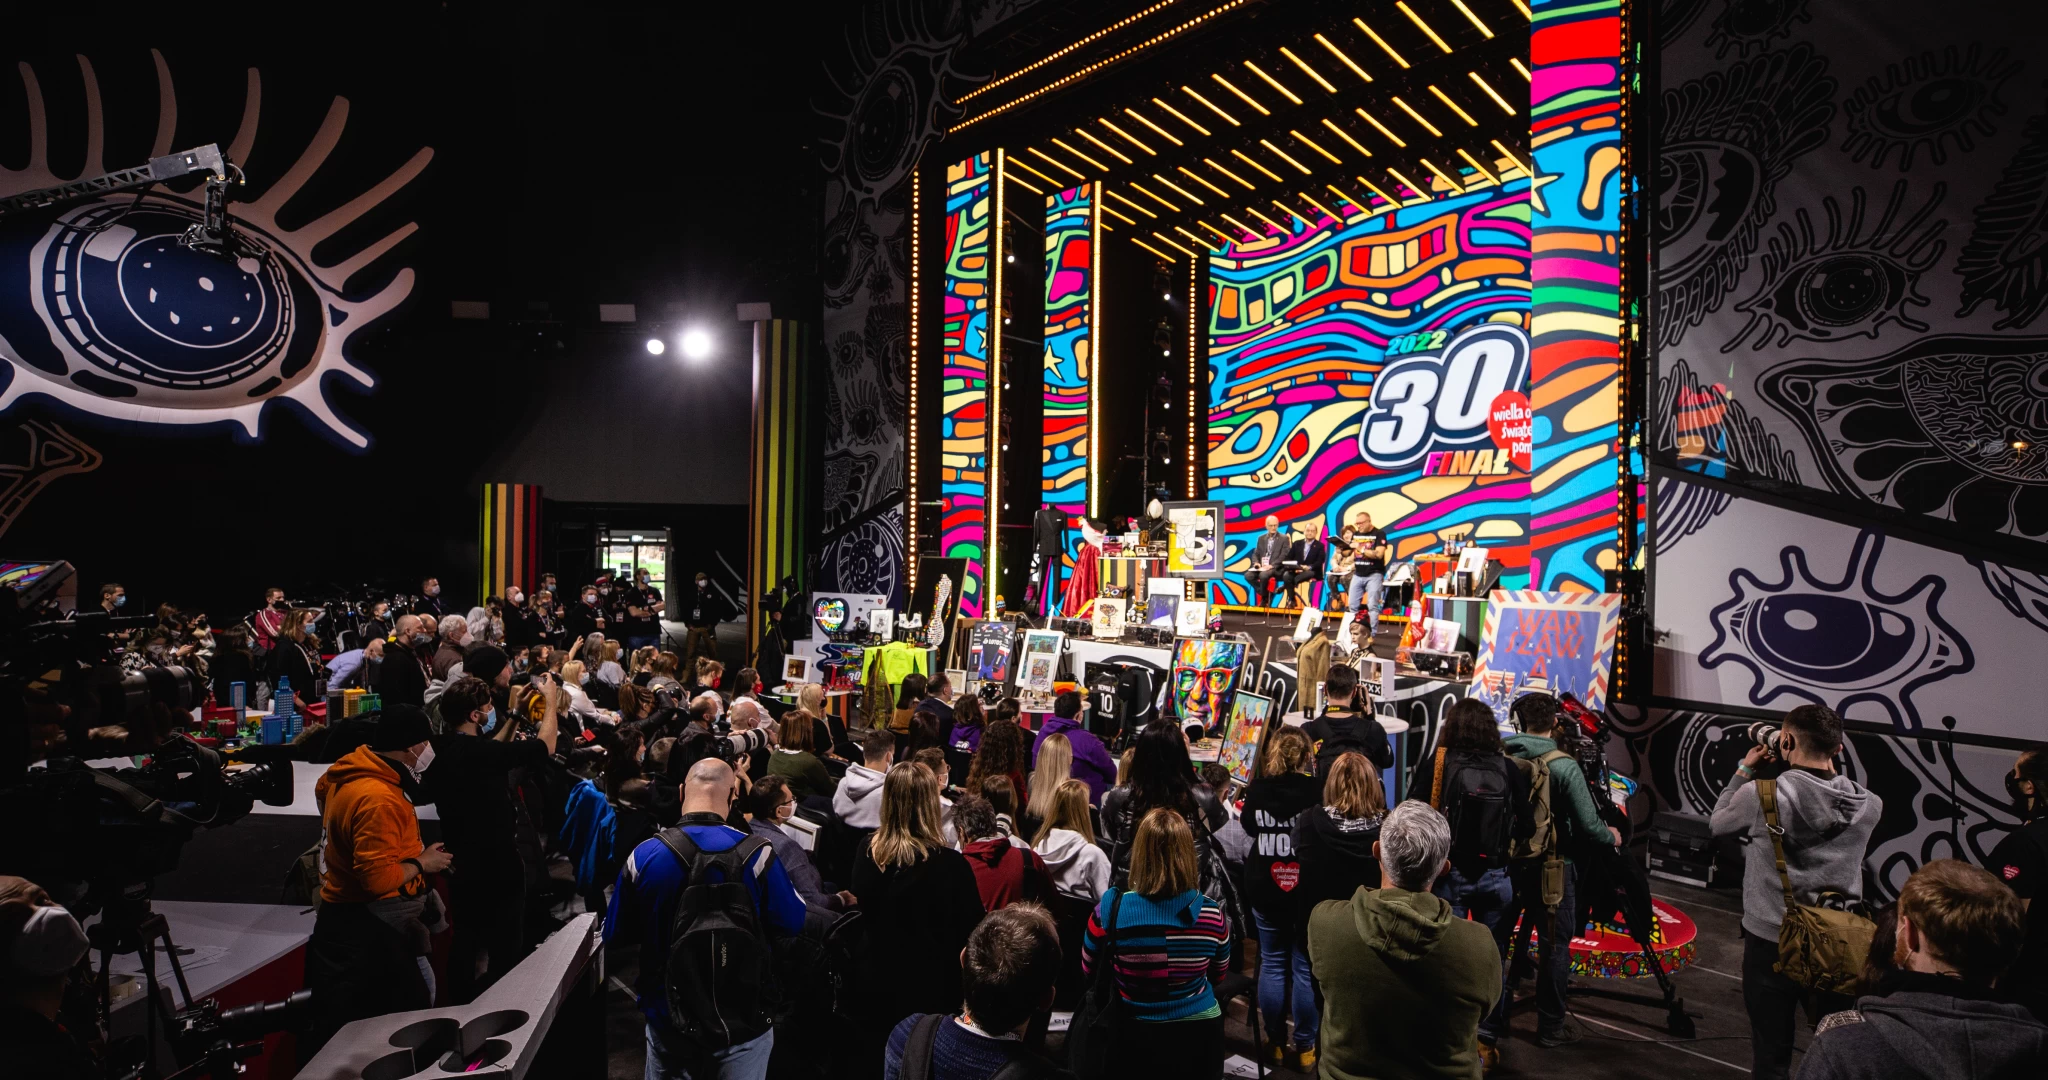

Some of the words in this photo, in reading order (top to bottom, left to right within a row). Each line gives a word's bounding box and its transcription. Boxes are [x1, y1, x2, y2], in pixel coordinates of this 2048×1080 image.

[1385, 330, 1448, 356] 2022
[1367, 338, 1516, 455] 30
[1493, 402, 1524, 421] wielka
[1423, 448, 1510, 476] FINAŁ
[1517, 608, 1581, 636] WAR
[1504, 631, 1584, 659] SZAW
[1100, 692, 1113, 713] 10
